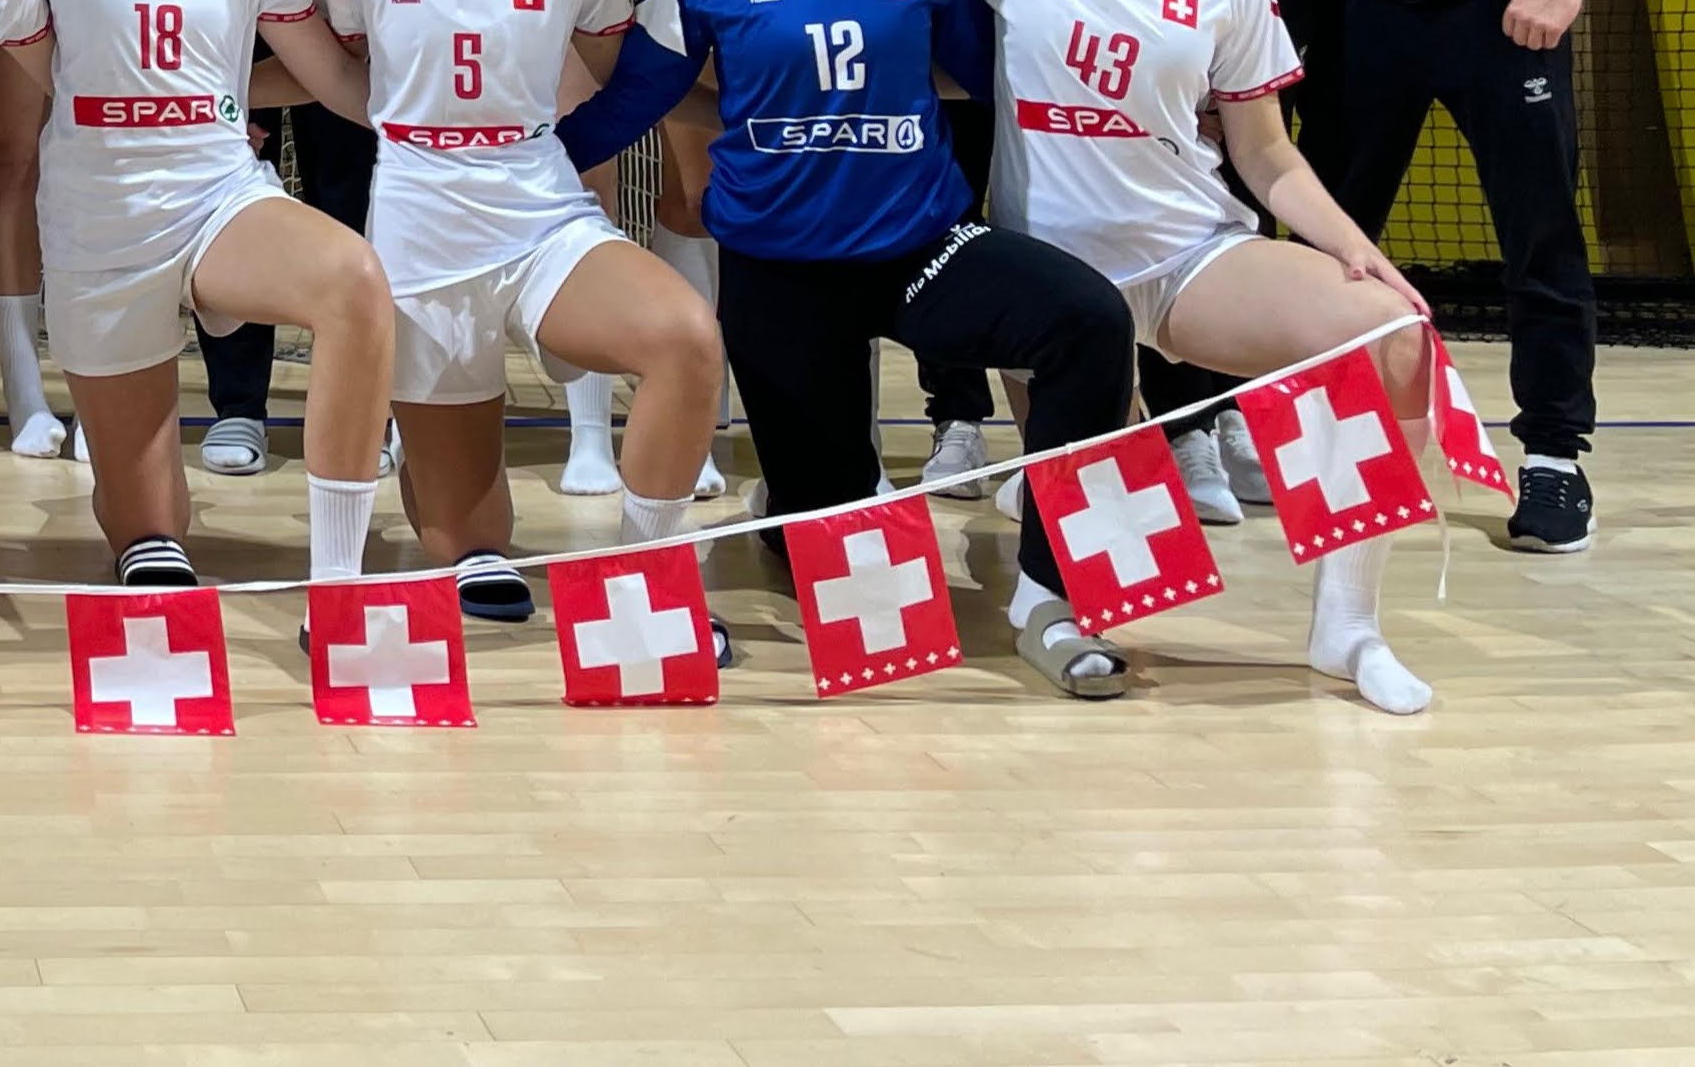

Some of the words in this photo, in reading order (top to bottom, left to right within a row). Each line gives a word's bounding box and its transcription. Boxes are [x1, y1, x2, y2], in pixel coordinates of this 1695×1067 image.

[134, 3, 183, 71] 18
[453, 33, 483, 100] 5
[804, 20, 866, 92] 12
[1065, 20, 1141, 101] 43
[102, 100, 214, 123] SPAR
[782, 122, 886, 146] SPAR
[1048, 108, 1145, 133] SPA
